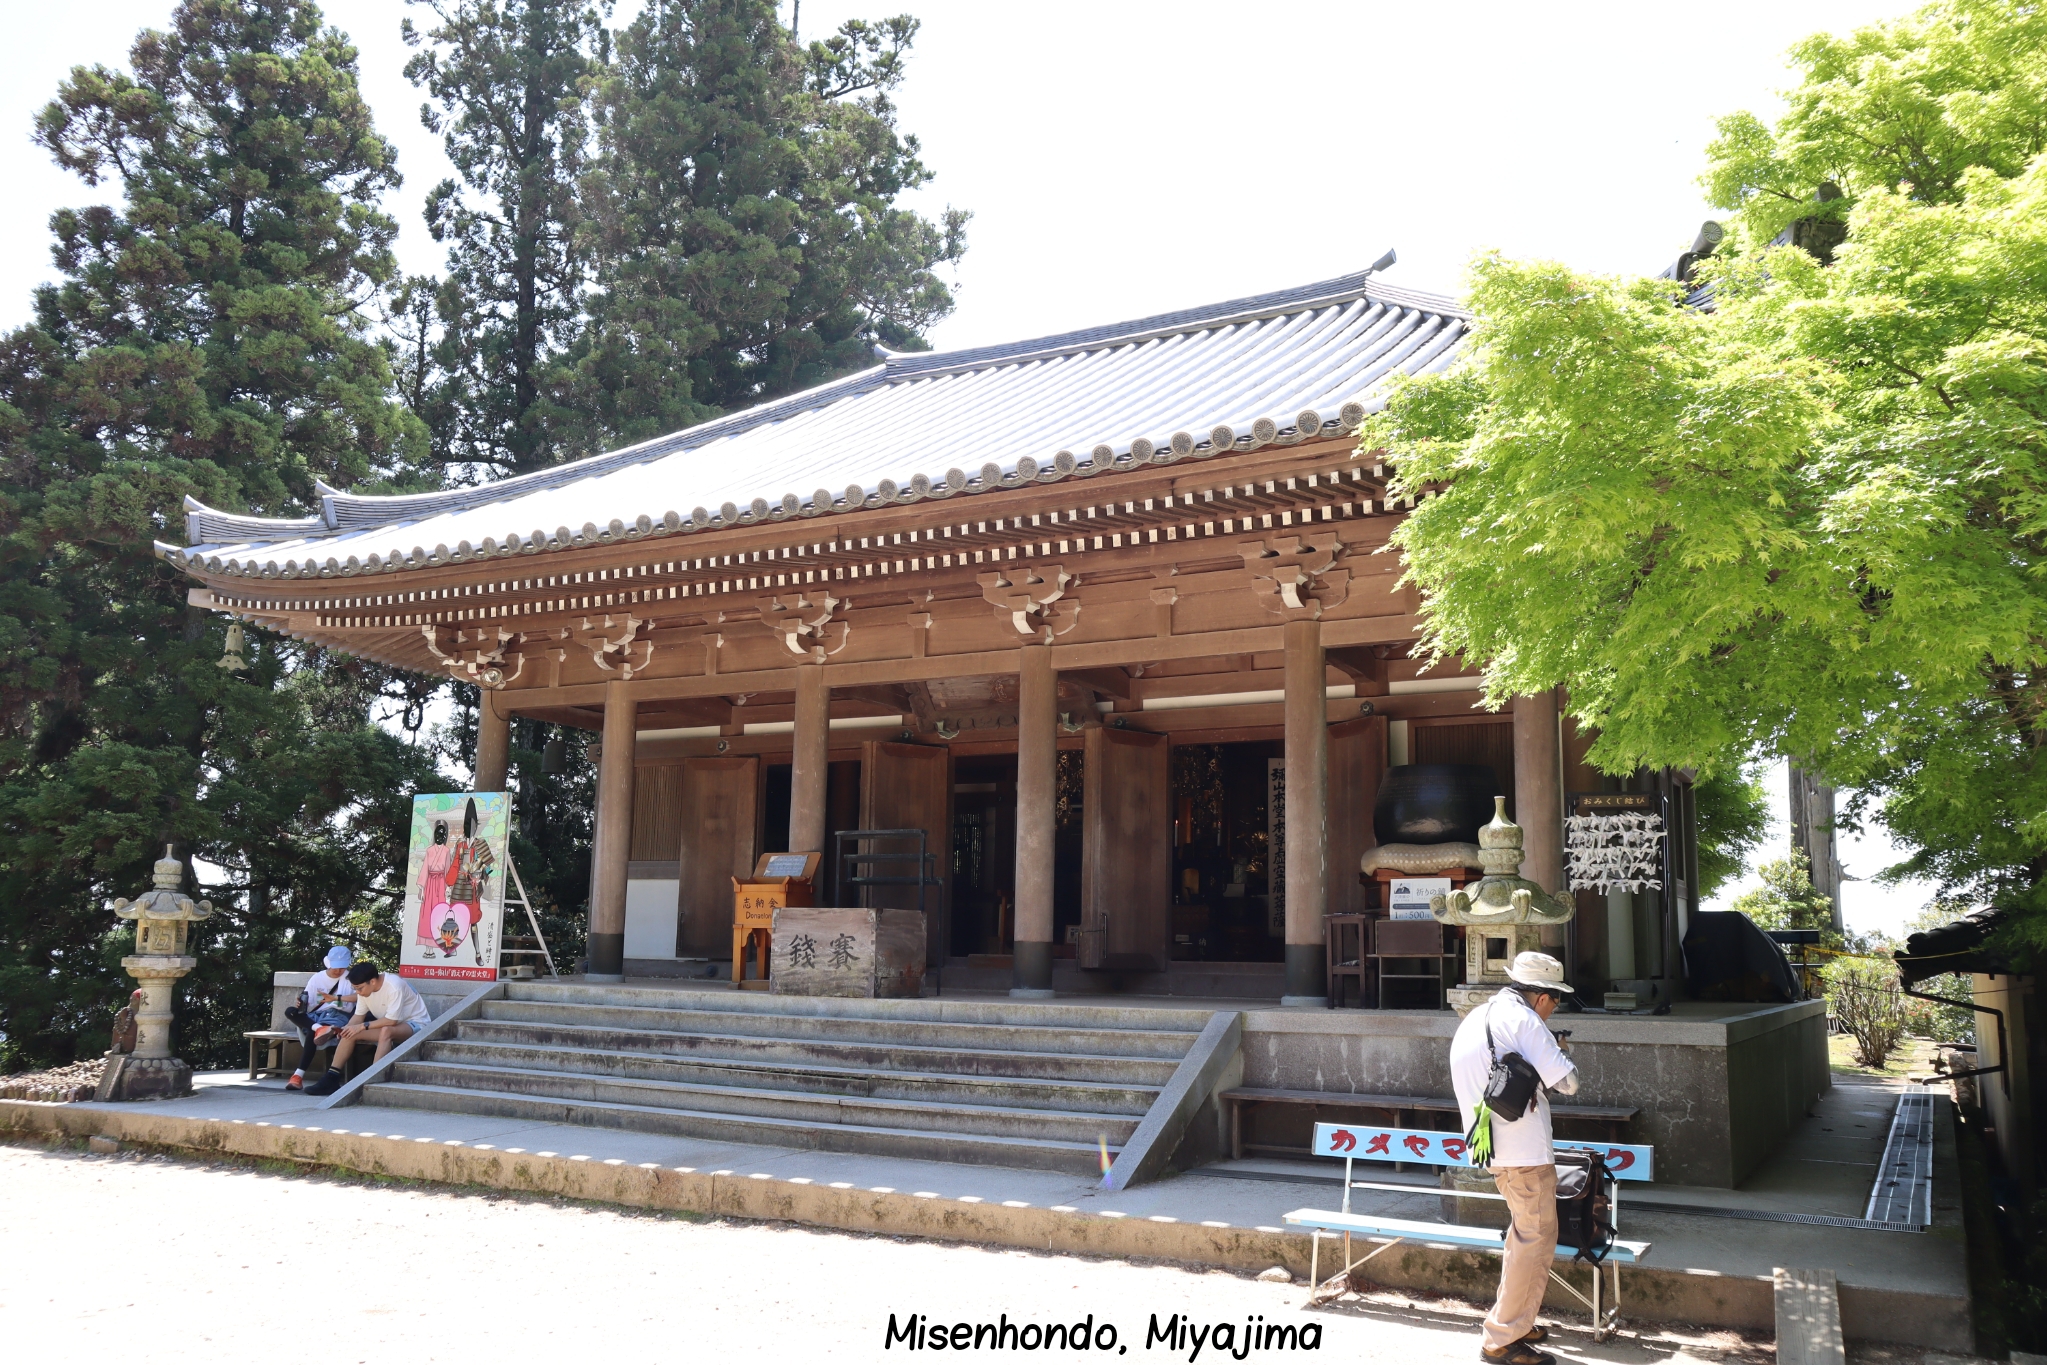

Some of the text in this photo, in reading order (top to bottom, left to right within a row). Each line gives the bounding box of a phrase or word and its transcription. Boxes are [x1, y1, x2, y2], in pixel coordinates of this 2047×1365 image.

[1583, 797, 1645, 805] おみくじ結び
[743, 897, 778, 909] 志納金
